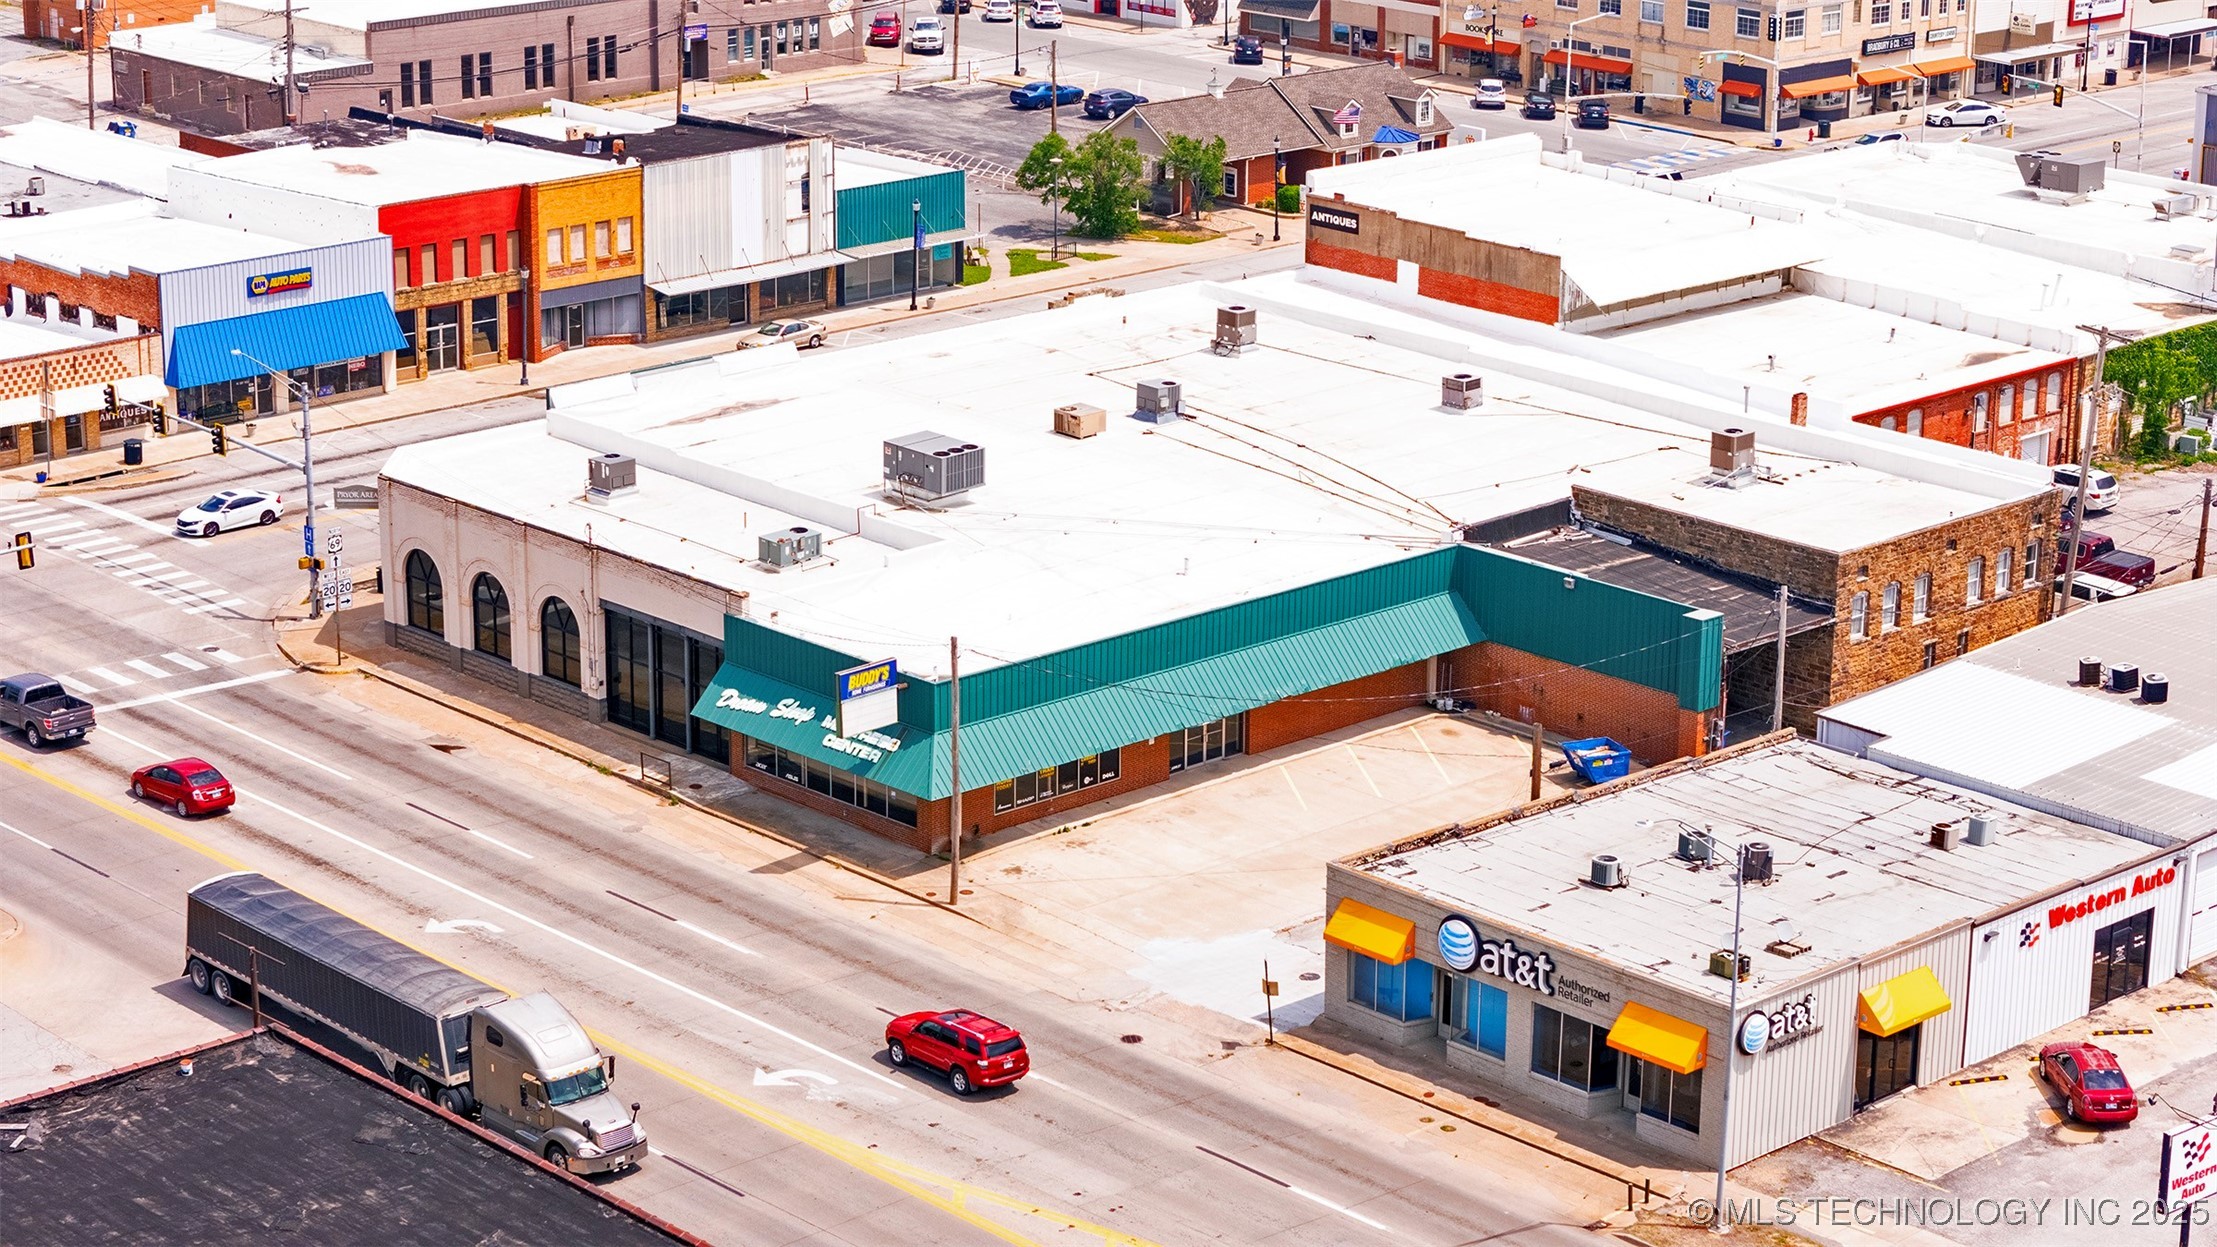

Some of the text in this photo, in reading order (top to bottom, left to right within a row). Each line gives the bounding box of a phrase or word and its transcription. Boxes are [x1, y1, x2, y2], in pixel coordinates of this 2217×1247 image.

[1465, 24, 1503, 37] BOOKSRE
[1312, 211, 1357, 228] ANTIQUES
[269, 276, 288, 288] AUTO
[289, 272, 311, 284] PARTS
[360, 490, 378, 498] AREA
[305, 530, 312, 540] H
[330, 538, 340, 550] 69
[324, 586, 336, 597] 20
[340, 582, 351, 593] 20
[848, 664, 890, 690] BUDDY'S
[716, 688, 768, 714] Dream
[822, 733, 882, 764] CENTER
[755, 762, 767, 770] acer
[785, 773, 798, 782] ASUS
[1016, 796, 1034, 804] SHARP
[2048, 867, 2176, 929] Western Auto
[1480, 941, 1552, 996] at&t
[1558, 975, 1610, 1003] Authorized
[1558, 986, 1594, 1008] Retailer
[1771, 994, 1817, 1040] at&t
[1766, 1025, 1824, 1054] Authorized Retailer
[2172, 1164, 2217, 1190] Western
[2181, 1182, 2206, 1200] Auto
